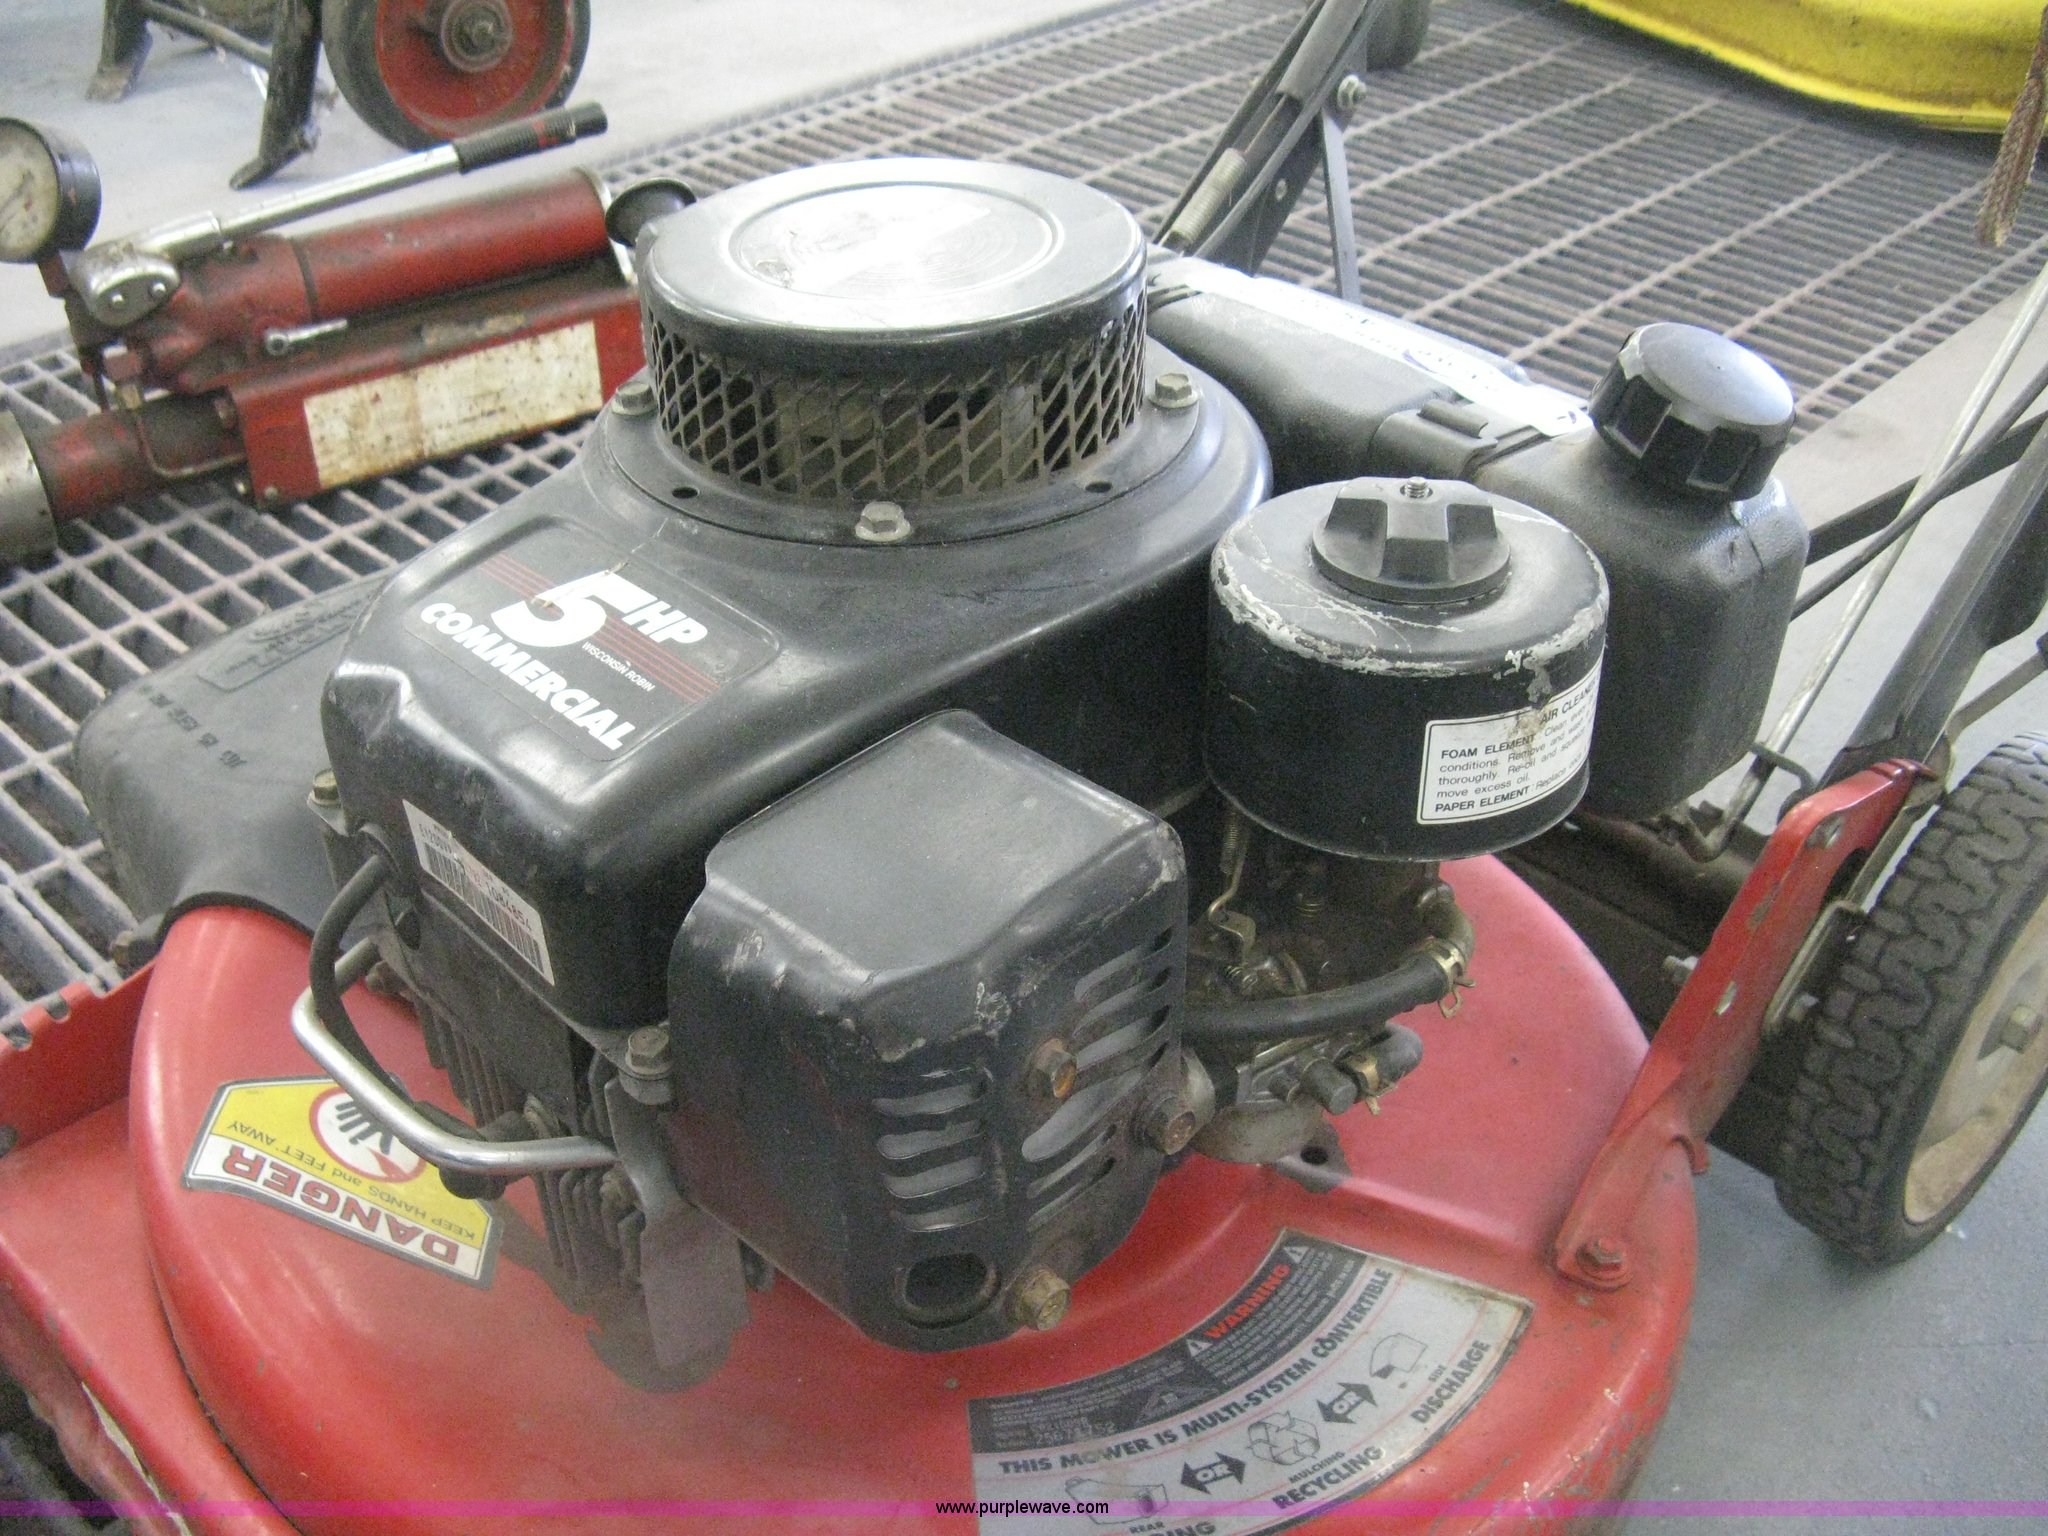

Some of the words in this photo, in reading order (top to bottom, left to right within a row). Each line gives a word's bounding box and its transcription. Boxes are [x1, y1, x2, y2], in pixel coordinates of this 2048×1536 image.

[491, 570, 657, 647] 5
[622, 602, 707, 644] HP
[420, 602, 637, 750] COMMERCIAL
[582, 641, 629, 674] WISCONSIN
[625, 670, 655, 691] ROBIN
[1540, 708, 1558, 726] AIR
[1441, 747, 1478, 759] FOAM
[1485, 734, 1536, 755] ELEMENT
[1507, 743, 1546, 762] Remove
[1507, 758, 1536, 775] Re-oil
[1541, 747, 1557, 762] and
[1437, 788, 1474, 798] move
[1474, 780, 1512, 795] excess
[1435, 800, 1475, 812] PAPER
[227, 1120, 275, 1144] AWAY
[278, 1146, 326, 1171] FEET
[332, 1167, 363, 1184] and
[222, 1145, 459, 1265] DANGER
[368, 1185, 427, 1220] HANDS
[427, 1217, 475, 1240] KEEP
[1204, 1264, 1291, 1339] WARNING
[998, 1457, 1052, 1474] THIS
[1060, 1438, 1152, 1468] MOWER
[1154, 1428, 1178, 1446] IS
[1182, 1354, 1317, 1437] MULTI-SYSTEM
[1311, 1268, 1394, 1359] CONVERTIBLE
[1410, 1340, 1491, 1424] DISCHARGE
[1428, 1364, 1448, 1383] SIDE
[1273, 1446, 1384, 1509] RECYCLING
[1288, 1450, 1346, 1484] MULCHING
